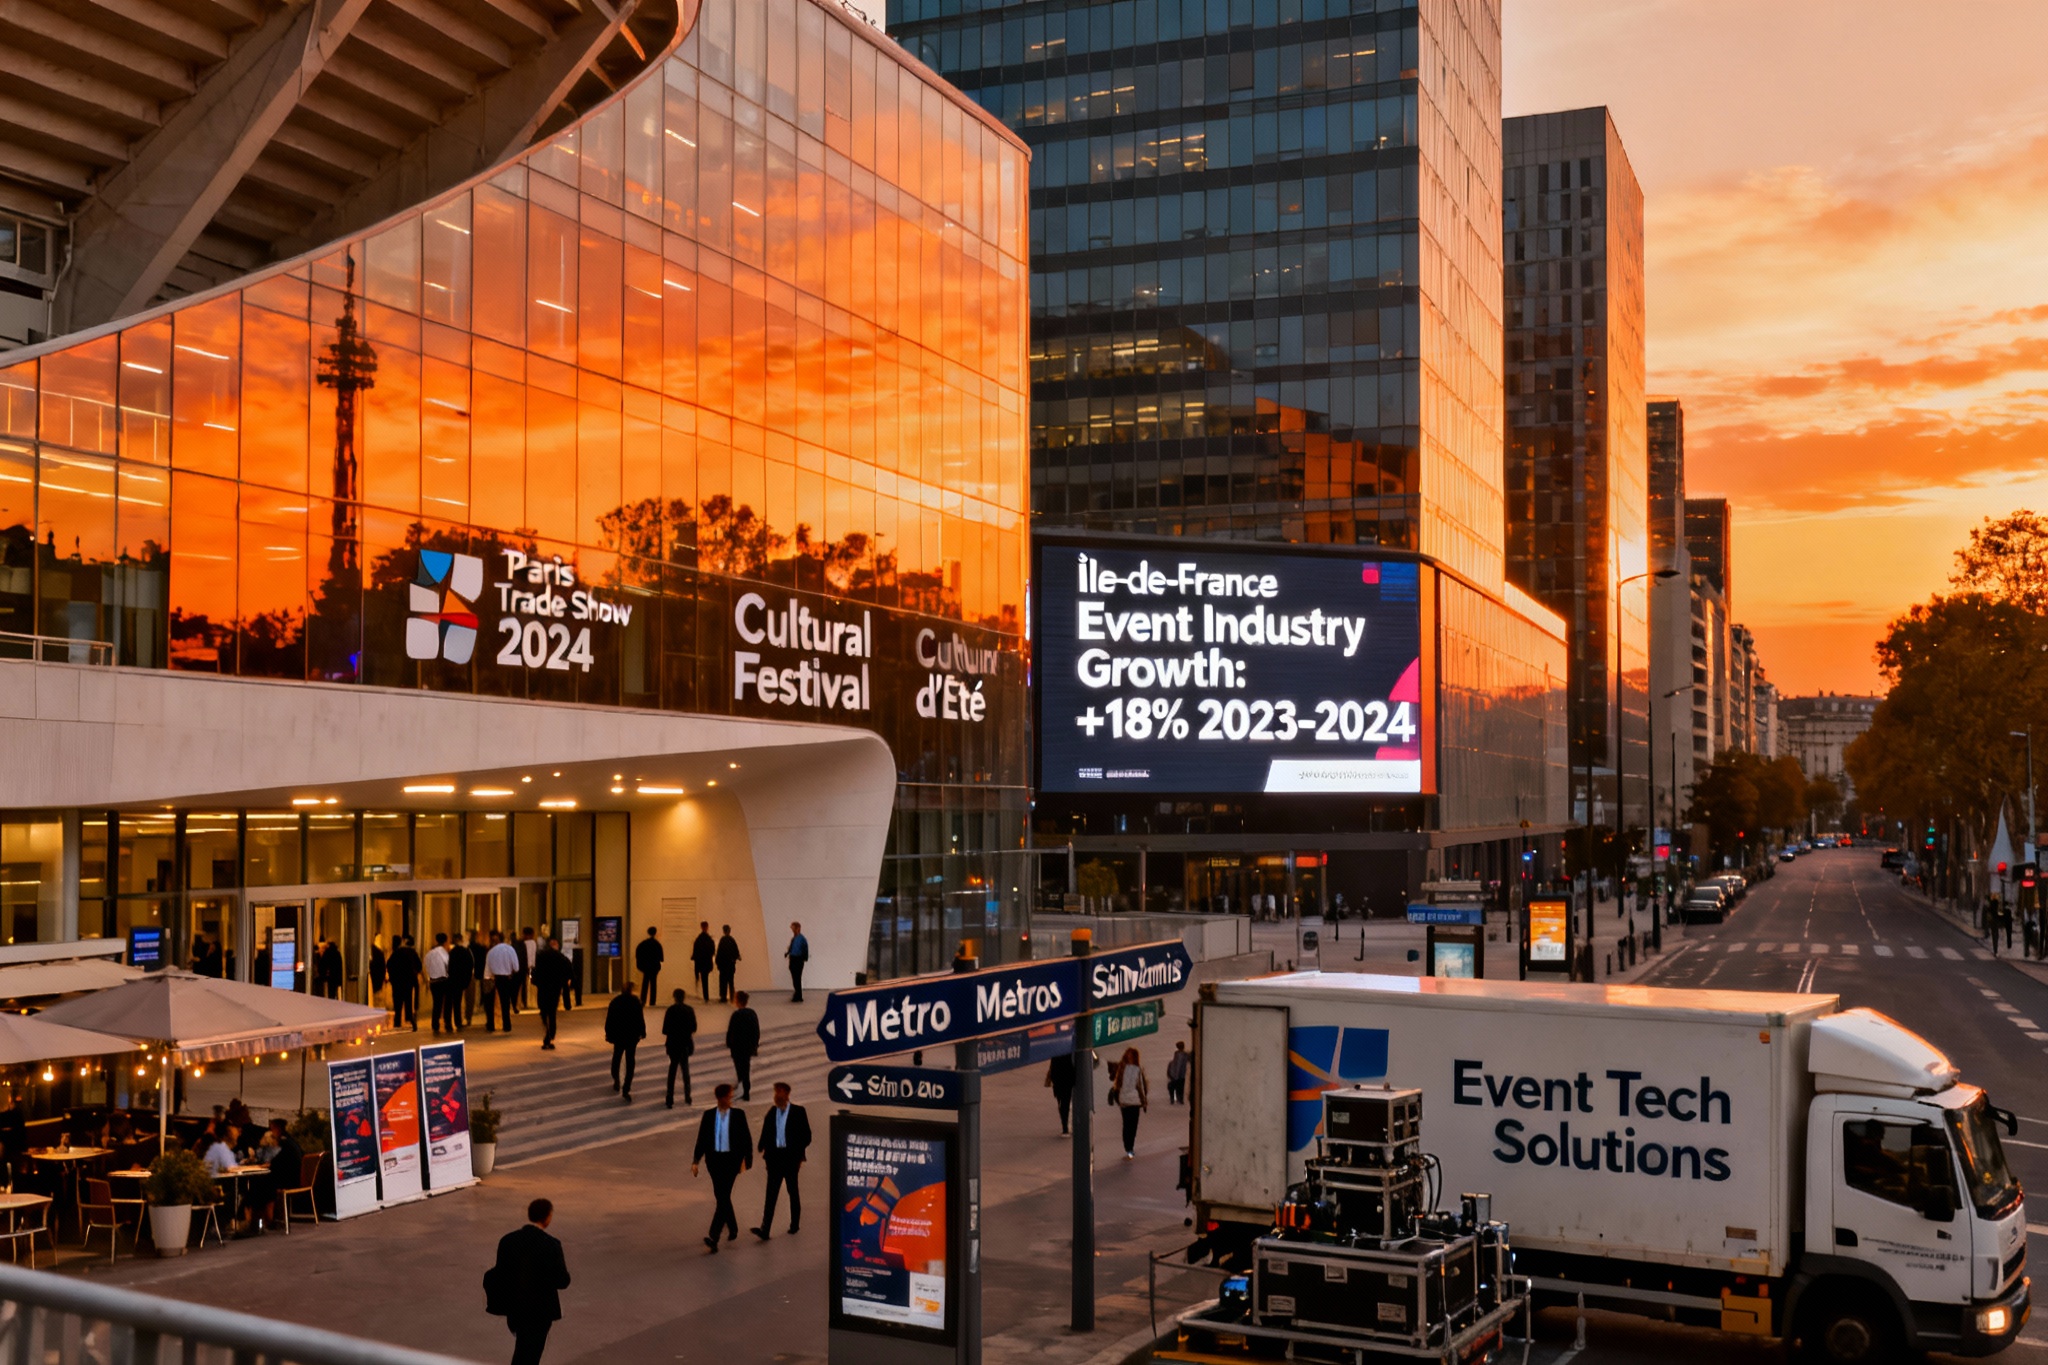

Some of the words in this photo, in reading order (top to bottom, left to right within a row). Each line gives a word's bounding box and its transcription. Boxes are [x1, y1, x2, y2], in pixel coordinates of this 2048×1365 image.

[500, 548, 575, 588] Paris
[494, 582, 567, 618] Trade
[571, 590, 633, 627] Show
[735, 592, 871, 657] Cultural
[1078, 601, 1193, 643] Event
[1203, 605, 1366, 657] Industry
[497, 616, 594, 673] 2024
[1077, 648, 1247, 689] Growth:
[734, 650, 870, 710] Festival
[1076, 696, 1190, 740] +18%
[1197, 698, 1417, 744] 2023-2024
[1453, 1059, 1594, 1113] Event
[1606, 1069, 1731, 1124] Tech
[1492, 1118, 1732, 1182] Solutions
